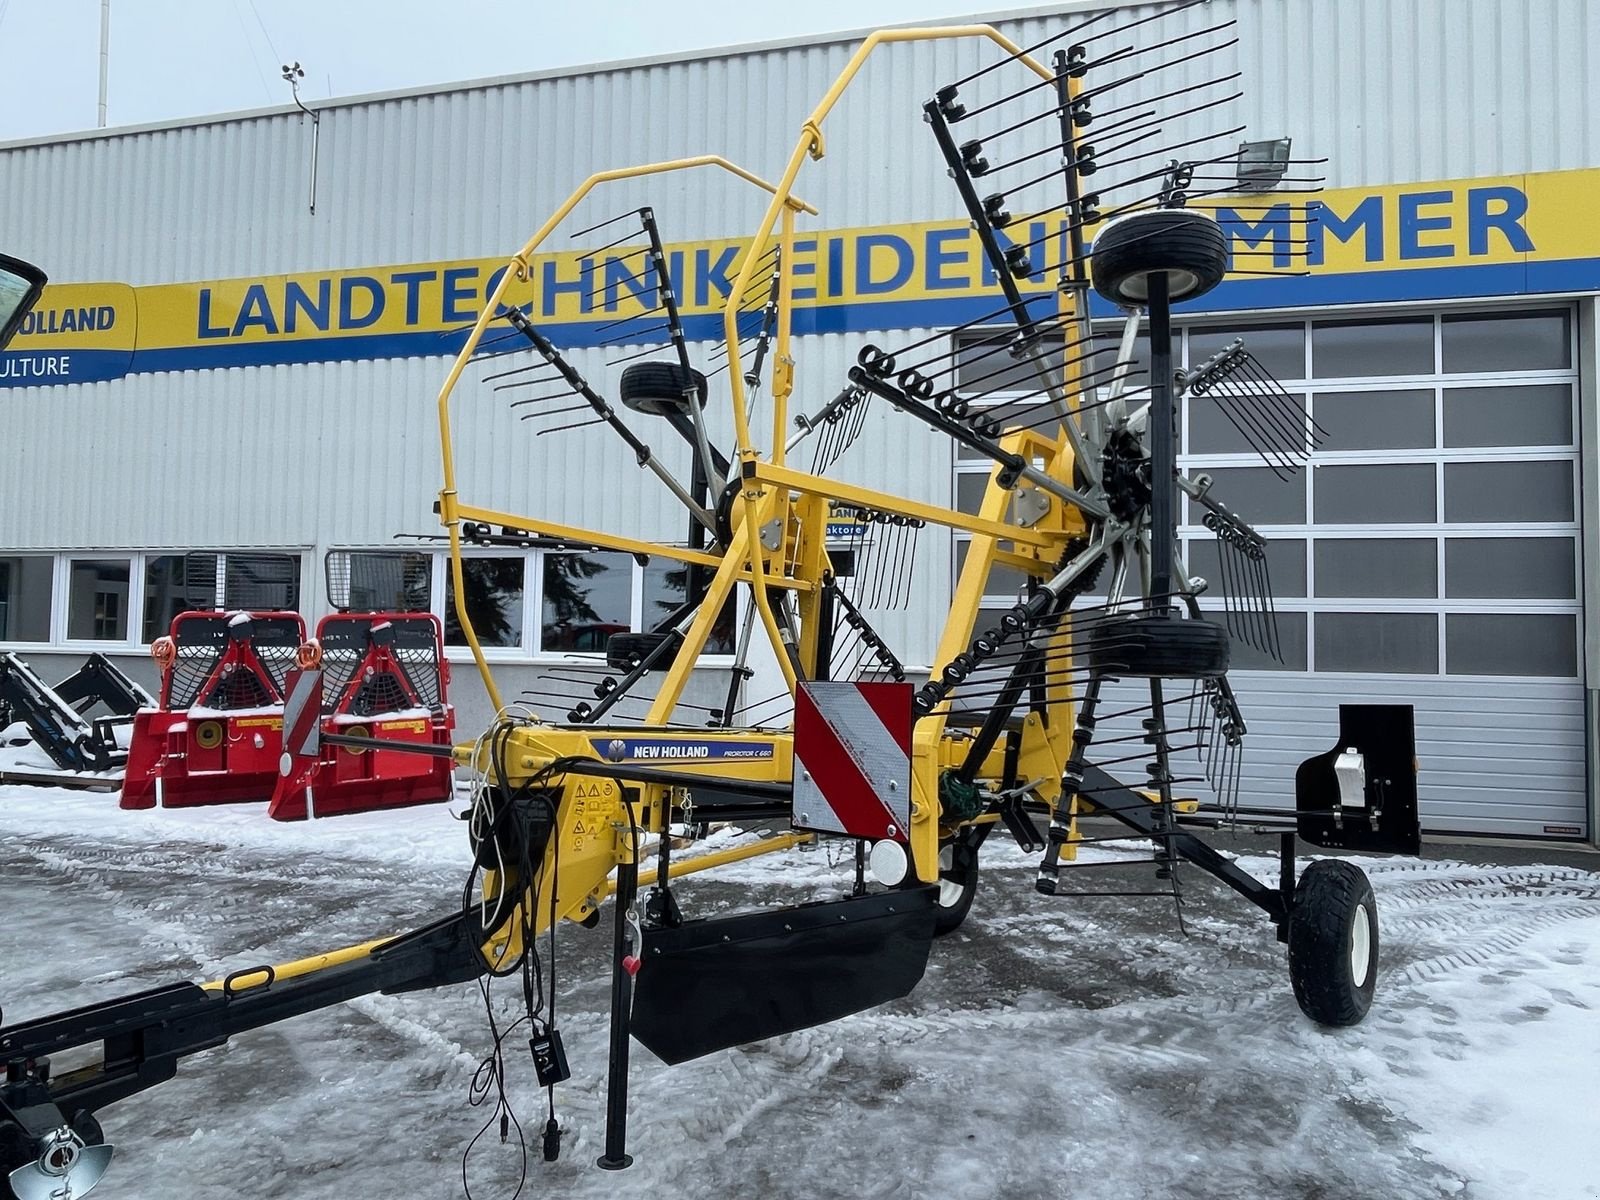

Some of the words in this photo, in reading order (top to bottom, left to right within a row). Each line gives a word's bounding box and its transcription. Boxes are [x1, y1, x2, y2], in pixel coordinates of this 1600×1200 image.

[198, 245, 746, 339] LANDTECHNIK
[18, 306, 115, 335] OLLAND
[826, 525, 862, 535] aktore
[633, 745, 660, 758] NEW
[661, 745, 709, 758] HOLLAND
